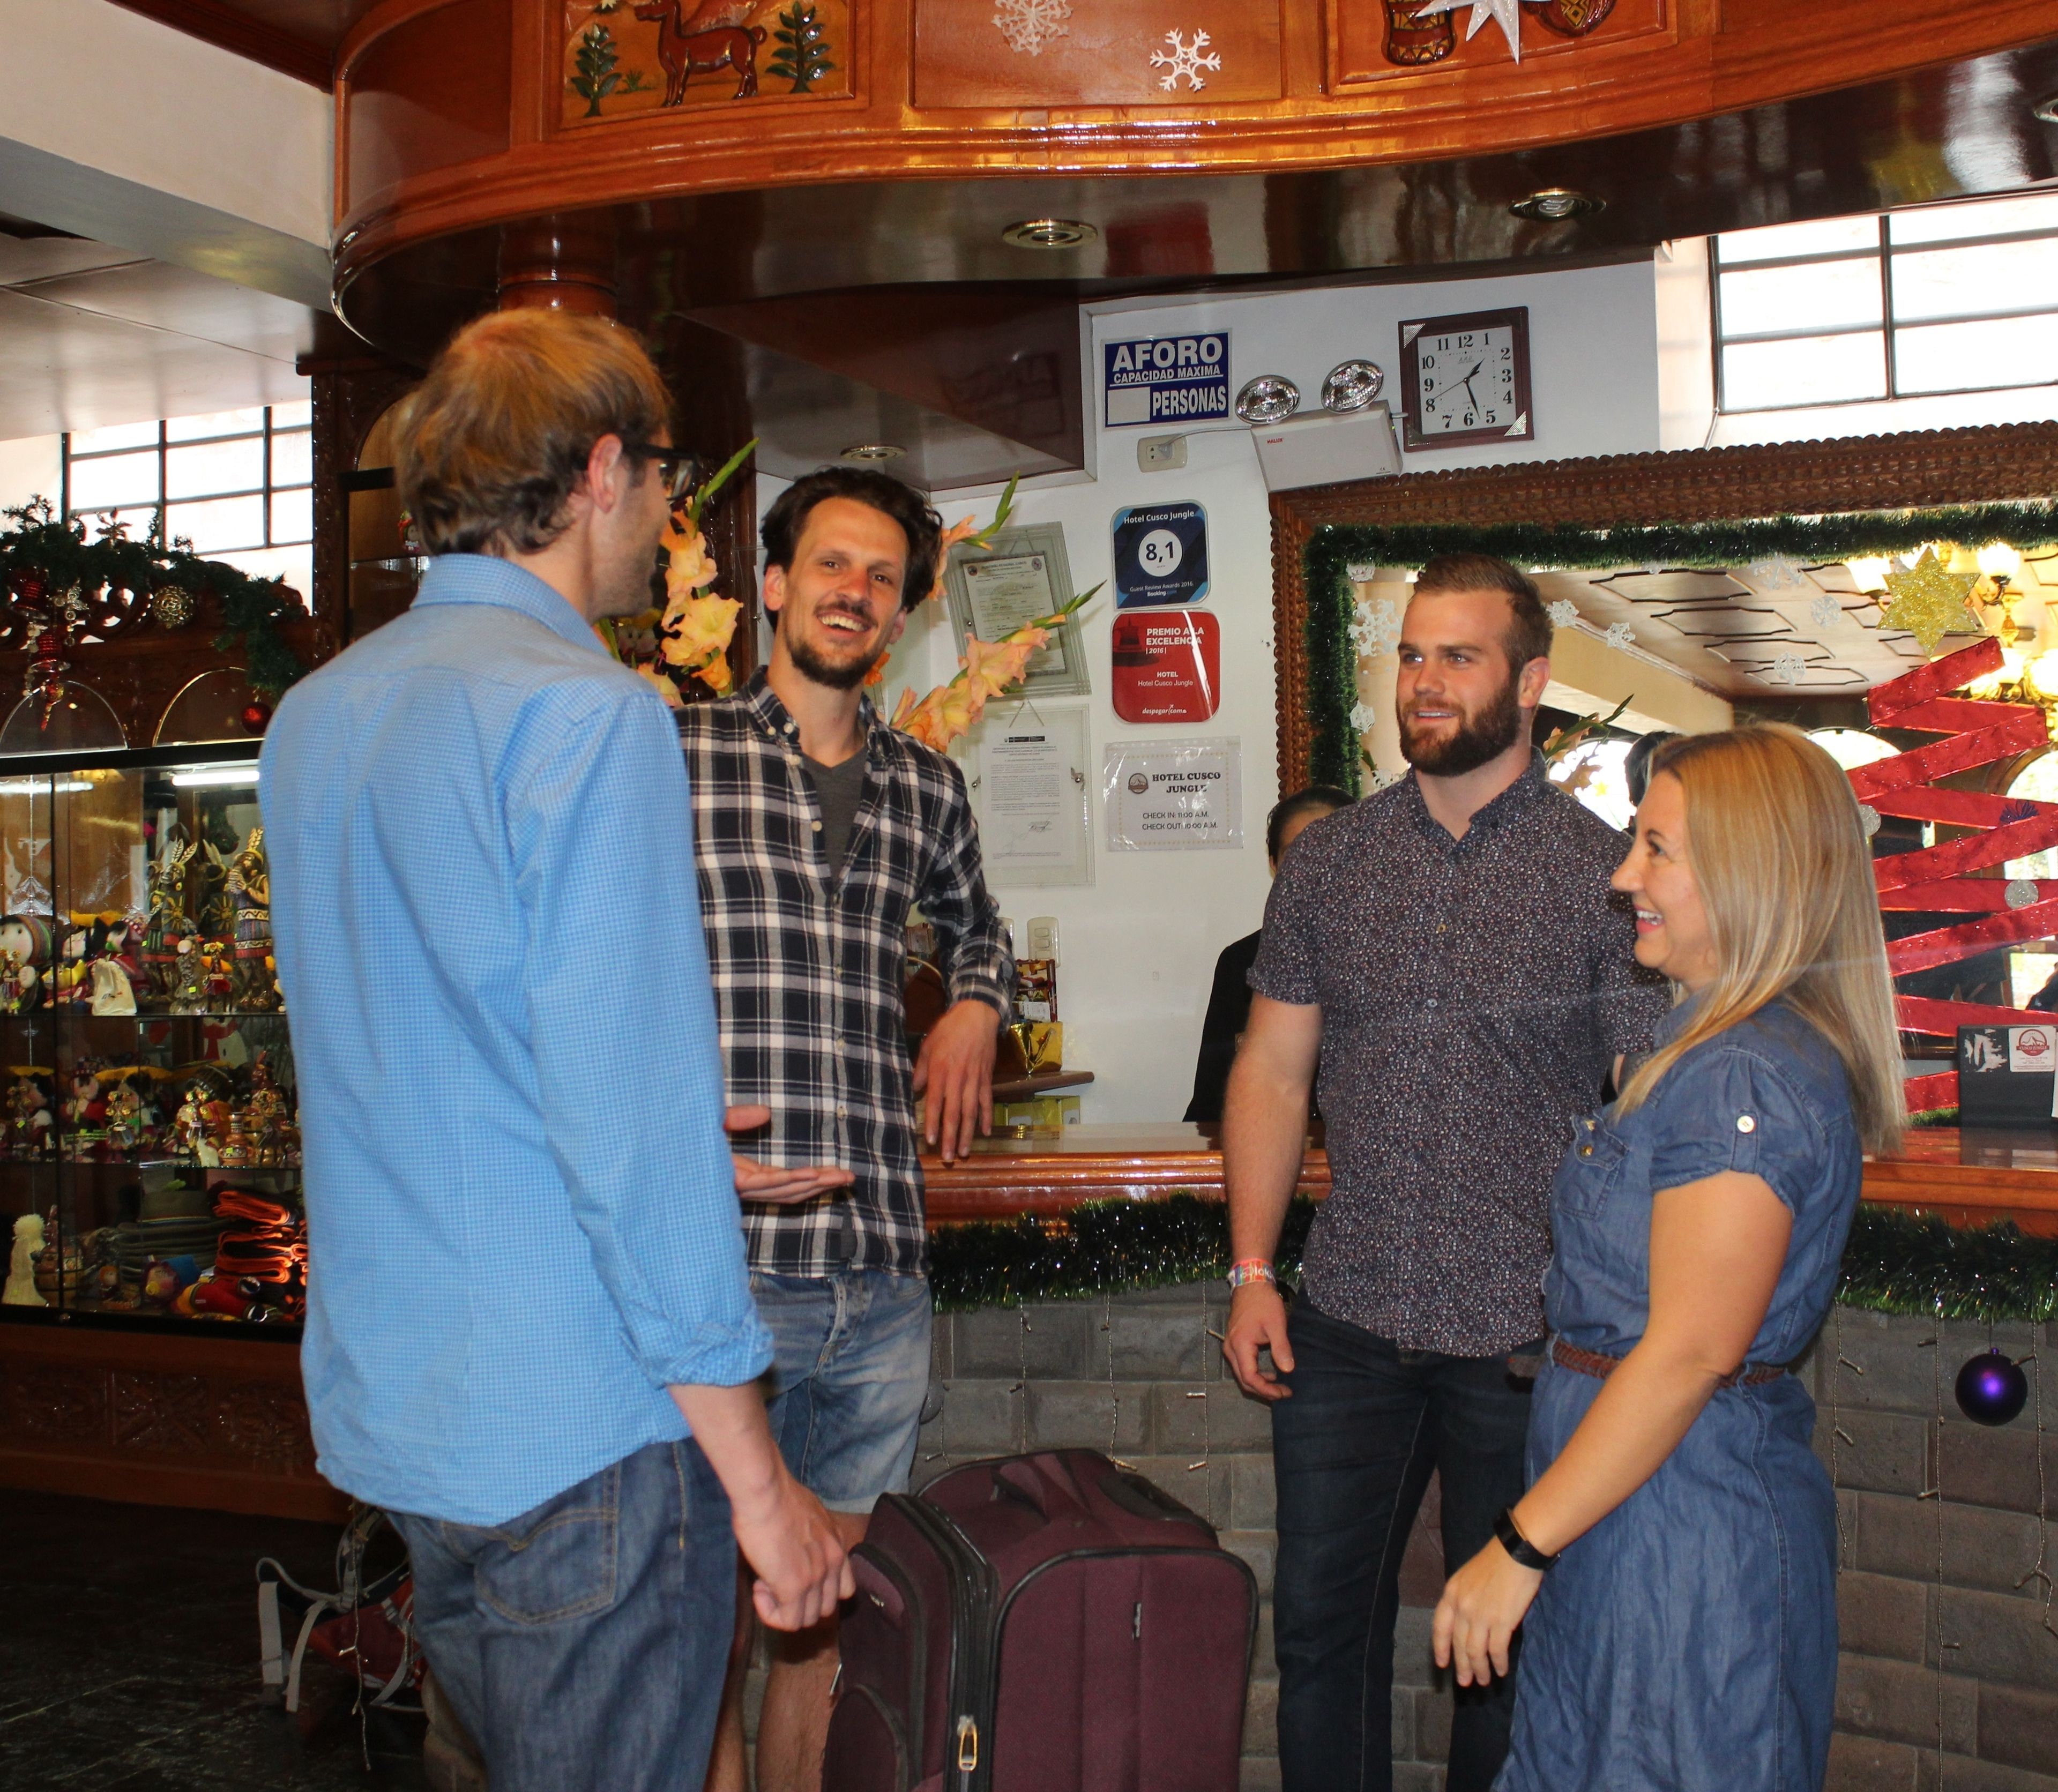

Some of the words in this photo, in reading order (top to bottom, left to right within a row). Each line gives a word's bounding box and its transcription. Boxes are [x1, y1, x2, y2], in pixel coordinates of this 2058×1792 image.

[1437, 337, 1449, 351] 11
[1458, 334, 1473, 348] 12
[1483, 333, 1490, 346] 1
[1112, 337, 1222, 372] AFORO
[1501, 347, 1511, 361] 2
[1421, 355, 1435, 369] 10
[1114, 369, 1174, 384] CAPACIDAD
[1177, 364, 1220, 378] MAXIMA
[1502, 369, 1512, 383] 3
[1424, 378, 1434, 392] 9
[1153, 385, 1226, 416] PERSONAS
[1503, 390, 1513, 404] 4
[1426, 398, 1435, 413] 8
[1442, 415, 1452, 429] 7
[1464, 412, 1474, 426] 6
[1486, 409, 1496, 423] 5
[1124, 514, 1144, 524] Hotel
[1169, 510, 1194, 521] Jungle
[1146, 541, 1174, 563] 8,1
[1147, 628, 1181, 636] PREMIO
[1183, 627, 1190, 635] A
[1146, 637, 1202, 645] EXCELENCA
[1152, 773, 1185, 781] HOTEL
[1187, 772, 1221, 780] CUSCO
[1166, 785, 1207, 793] JUNGLE
